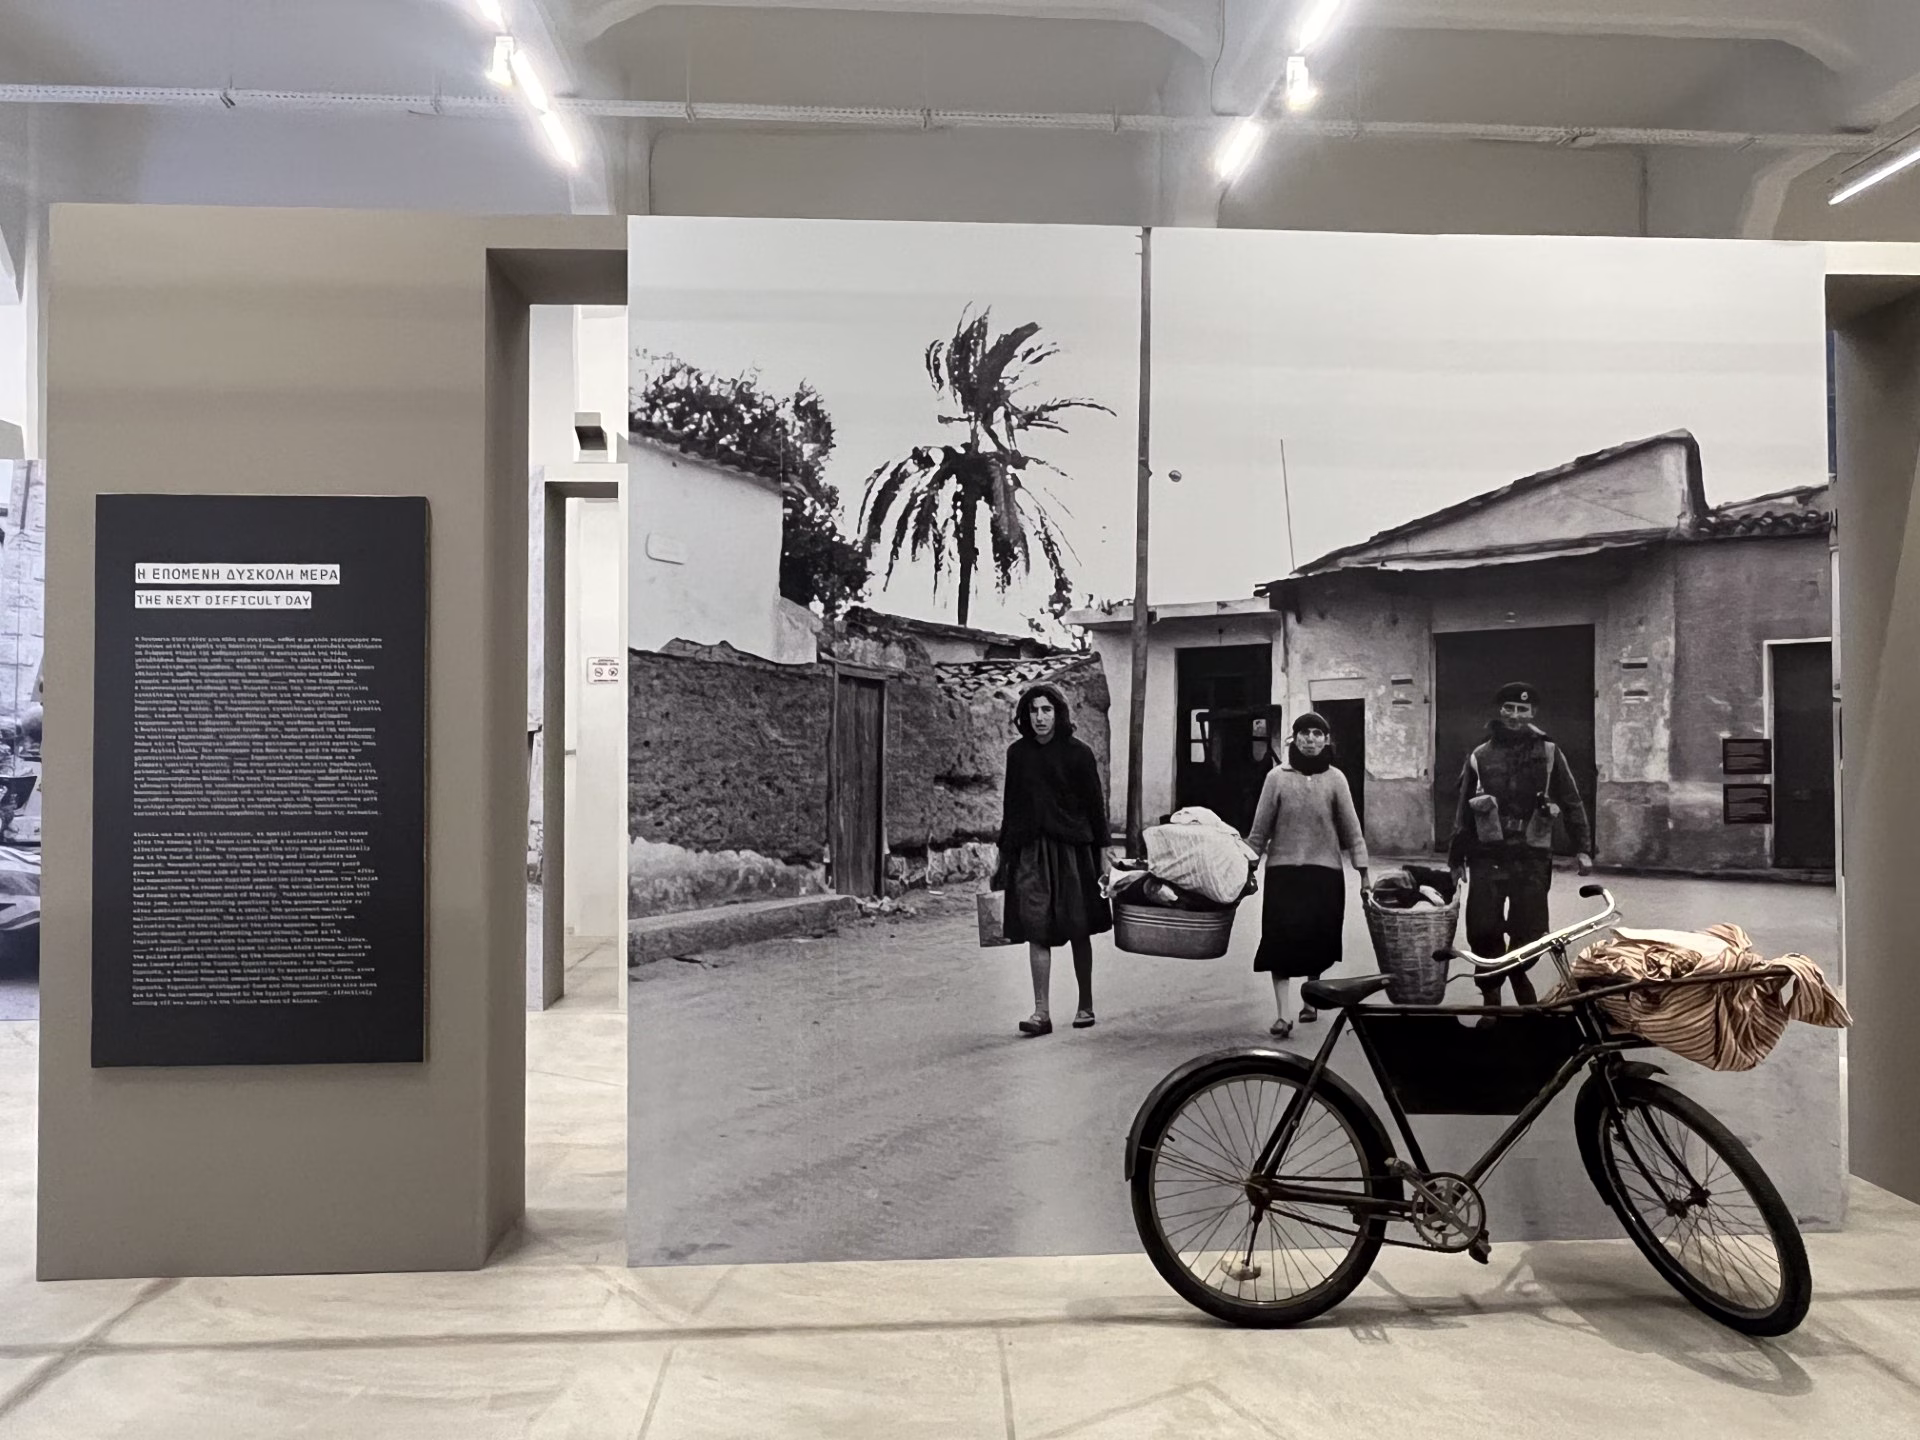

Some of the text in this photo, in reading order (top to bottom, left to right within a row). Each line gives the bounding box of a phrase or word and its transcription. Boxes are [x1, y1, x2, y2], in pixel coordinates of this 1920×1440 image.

[137, 568, 338, 581] Η ΕΠΟΜΕΝΗ ΔΥΣΚΟΛΗ ΜΕΡΑ
[136, 594, 310, 606] THE NEXT DIFFICULT DAY
